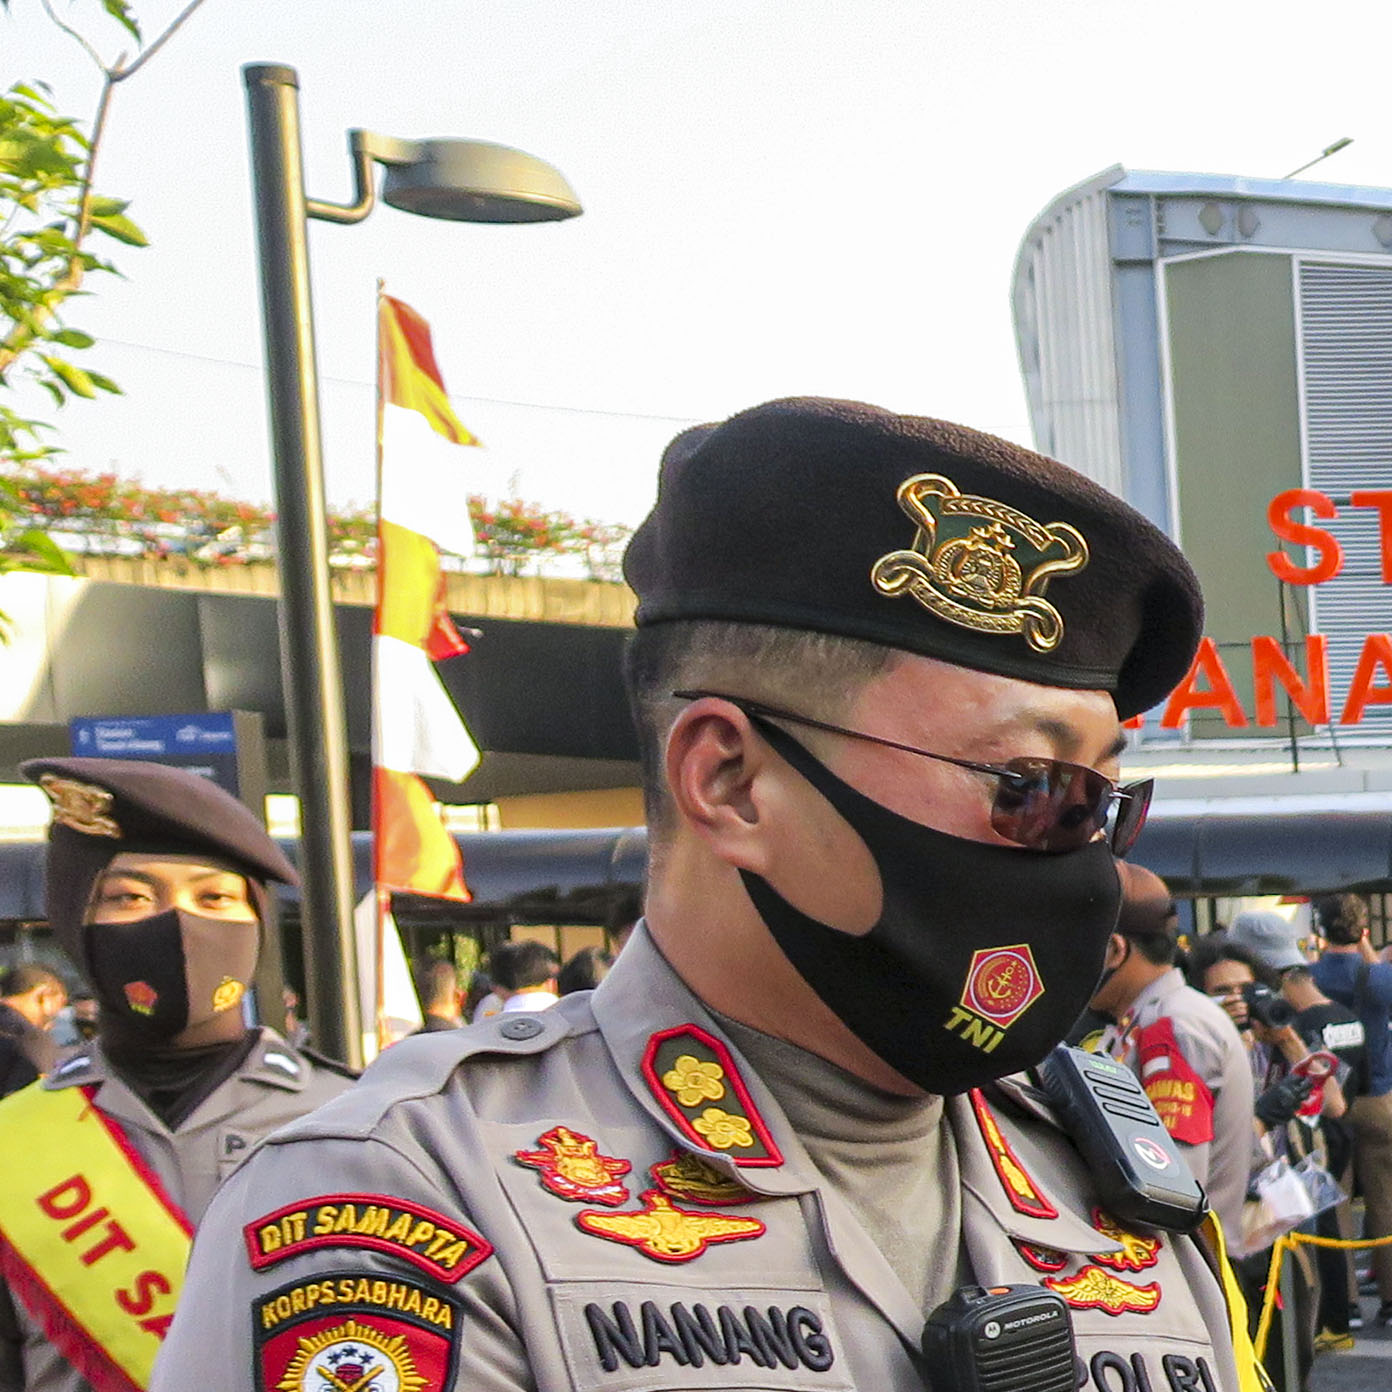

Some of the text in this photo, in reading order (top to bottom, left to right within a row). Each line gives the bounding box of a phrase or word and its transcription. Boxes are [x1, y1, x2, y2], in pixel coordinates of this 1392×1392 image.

[945, 1006, 1005, 1054] TNI
[37, 1174, 136, 1267] DIT
[260, 1204, 468, 1268] DIT SAMAPTA
[585, 1301, 835, 1372] NANANG
[1004, 1310, 1060, 1330] MOTOROLA
